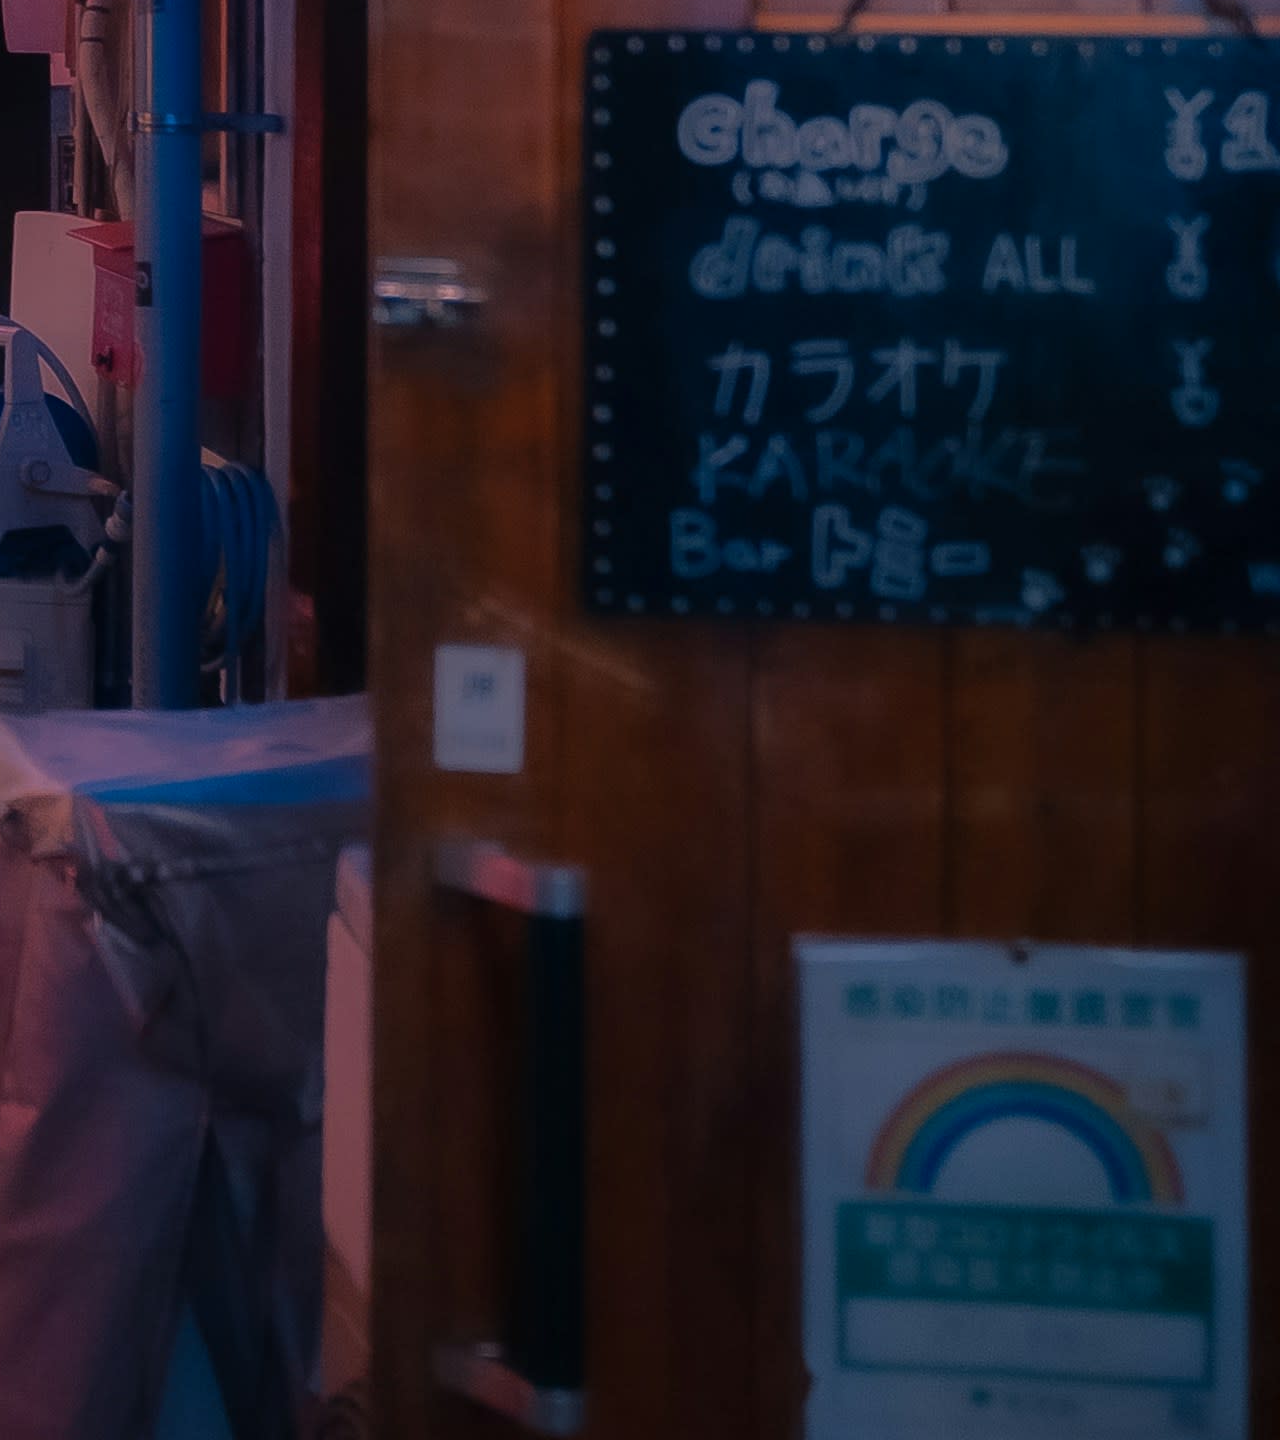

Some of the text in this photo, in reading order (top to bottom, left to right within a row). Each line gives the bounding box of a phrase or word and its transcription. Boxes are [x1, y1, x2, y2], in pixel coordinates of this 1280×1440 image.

[981, 232, 1098, 295] ALL
[705, 337, 1010, 426] カラオケ
[690, 420, 1090, 512] KARAOKE
[666, 508, 792, 579] Bar
